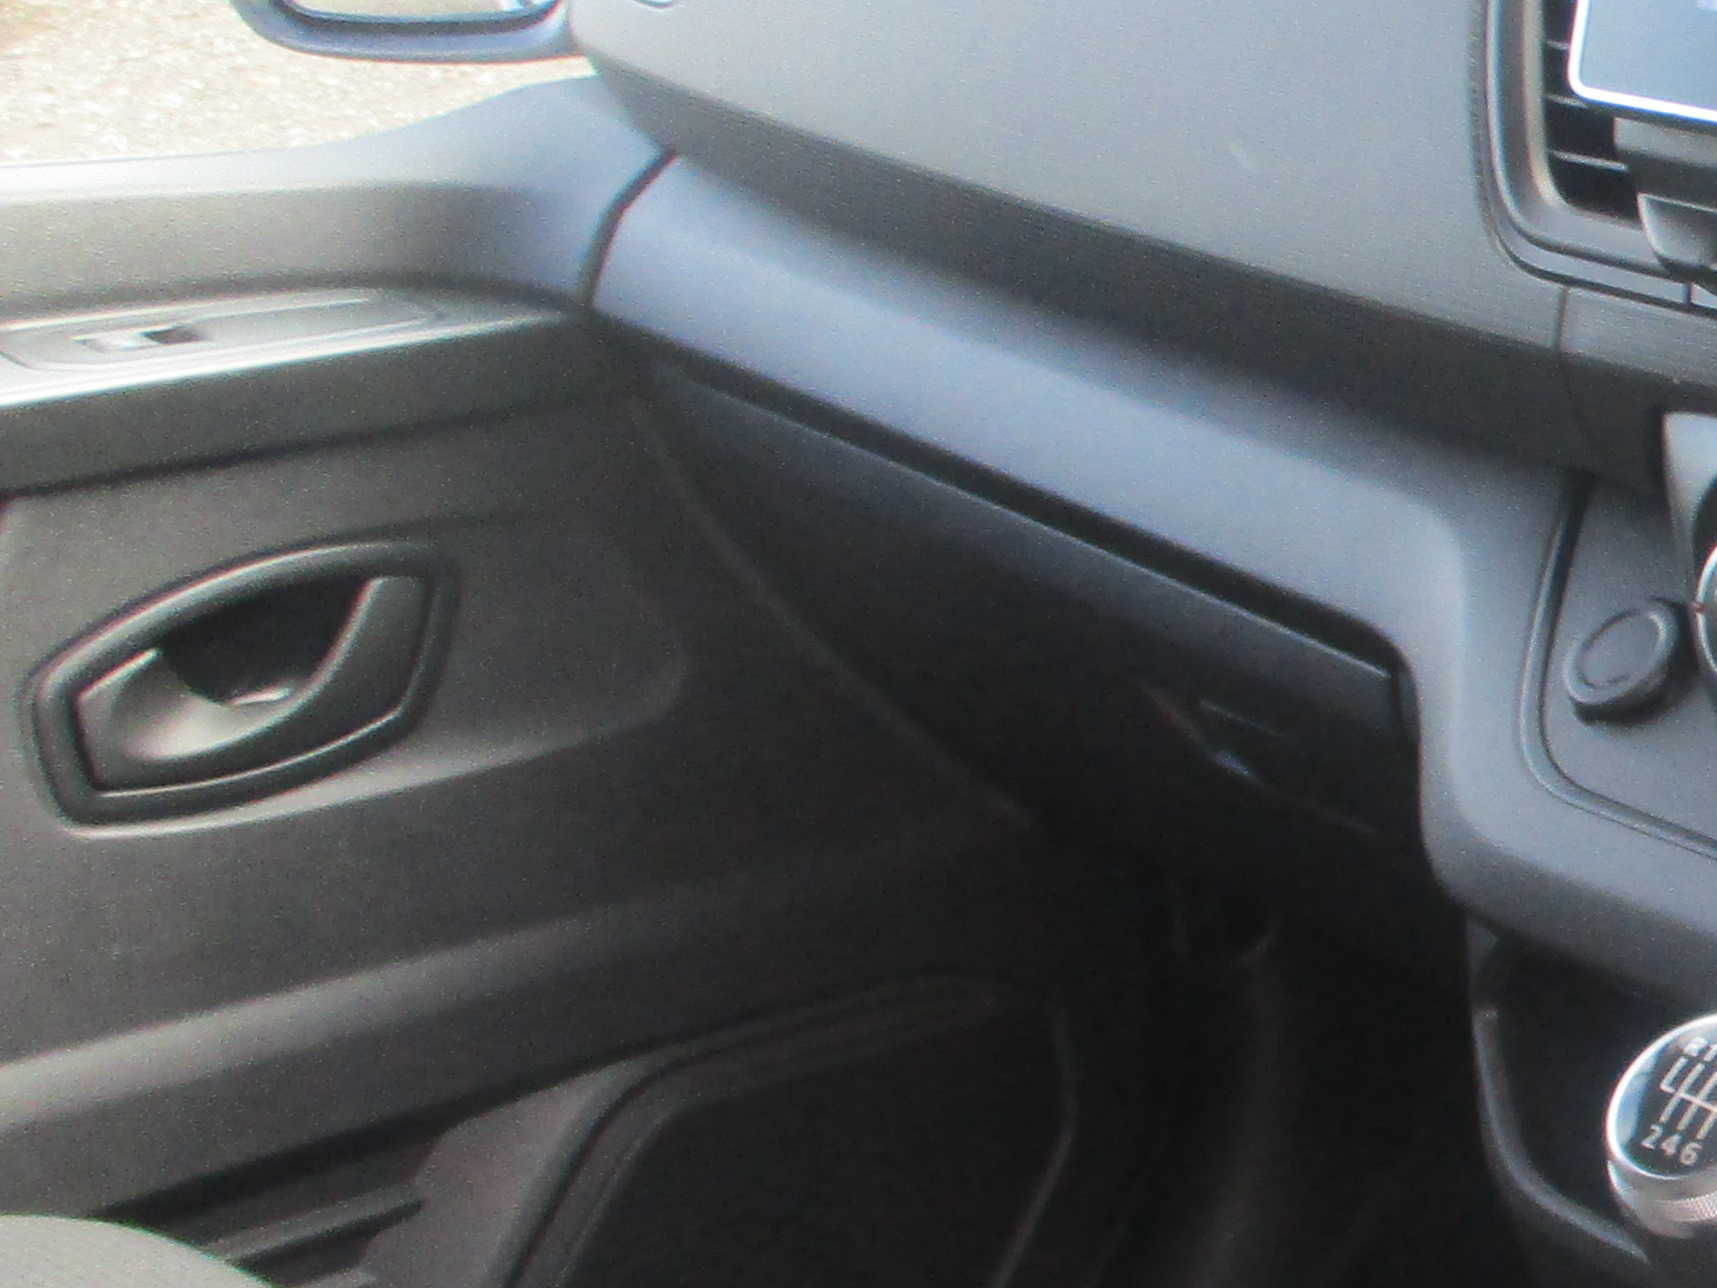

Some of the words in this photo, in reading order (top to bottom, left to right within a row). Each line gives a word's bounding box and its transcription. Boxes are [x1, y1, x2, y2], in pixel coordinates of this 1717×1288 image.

[1641, 1124, 1663, 1150] 2
[1661, 1133, 1682, 1157] 4
[1680, 1142, 1704, 1166] 6
